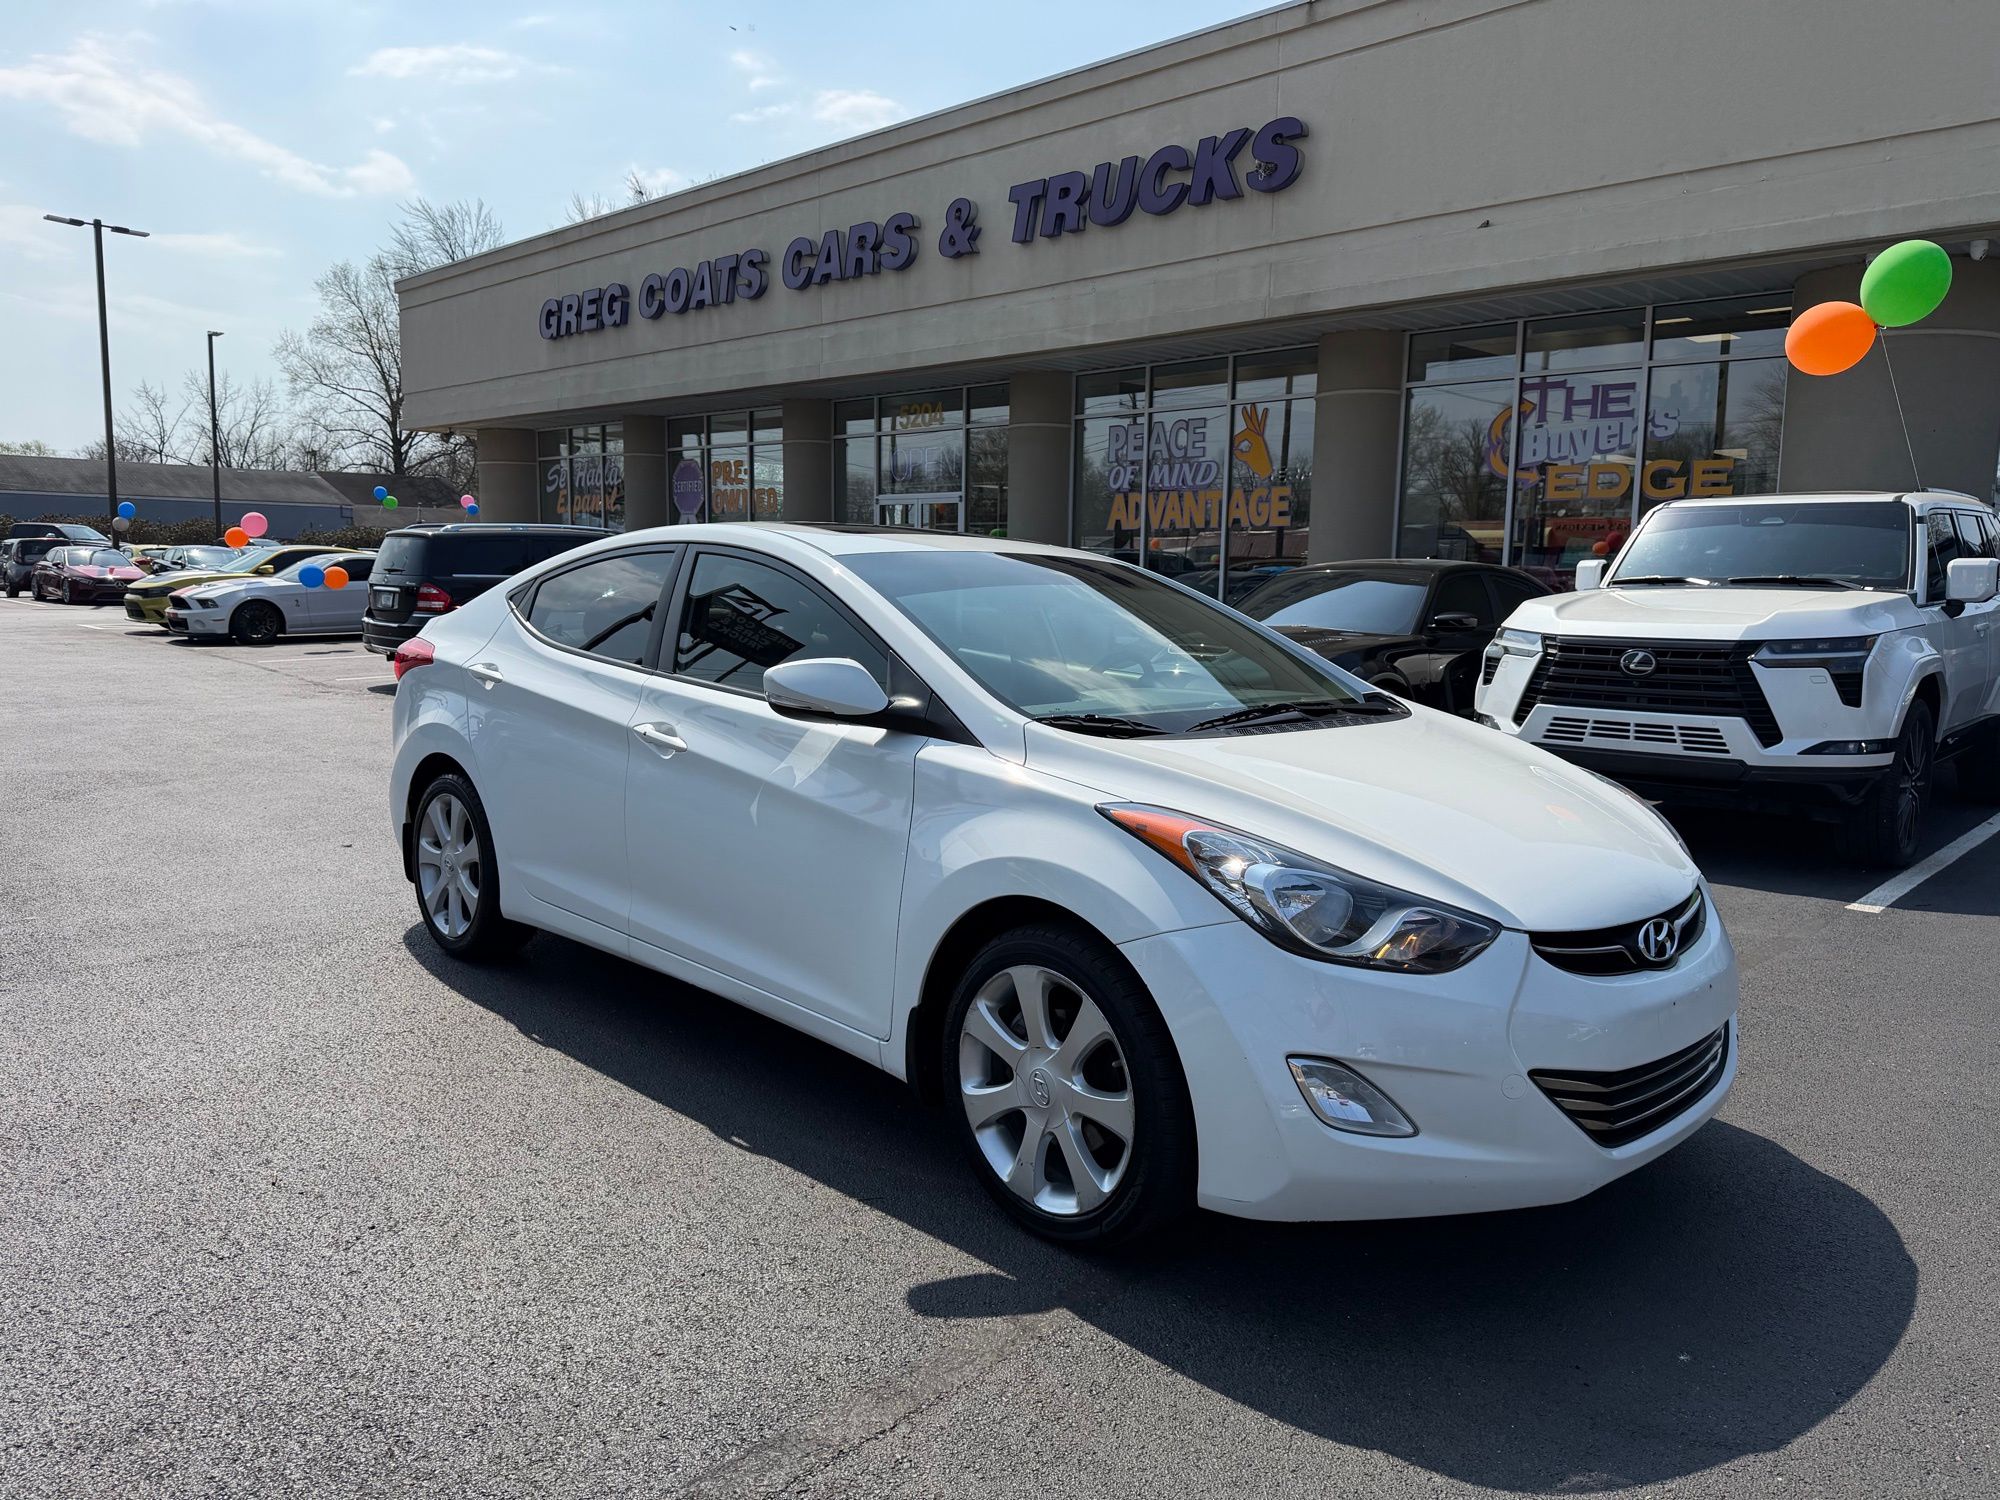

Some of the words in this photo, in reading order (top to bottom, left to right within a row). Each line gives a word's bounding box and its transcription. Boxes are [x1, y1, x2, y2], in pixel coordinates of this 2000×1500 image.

[539, 283, 629, 339] GREG
[639, 249, 770, 320] COATS
[782, 212, 920, 291] CARS
[938, 197, 982, 260] &
[1008, 116, 1309, 243] TRUCKS
[898, 401, 945, 429] 5204
[1521, 379, 1637, 423] THE
[1108, 417, 1206, 463] PEACE
[673, 480, 704, 493] CERTIFIED
[1108, 465, 1140, 492] OF
[1149, 460, 1219, 490] MIND
[1544, 459, 1735, 501] EDGE
[1106, 486, 1292, 531] ADVANTAGE
